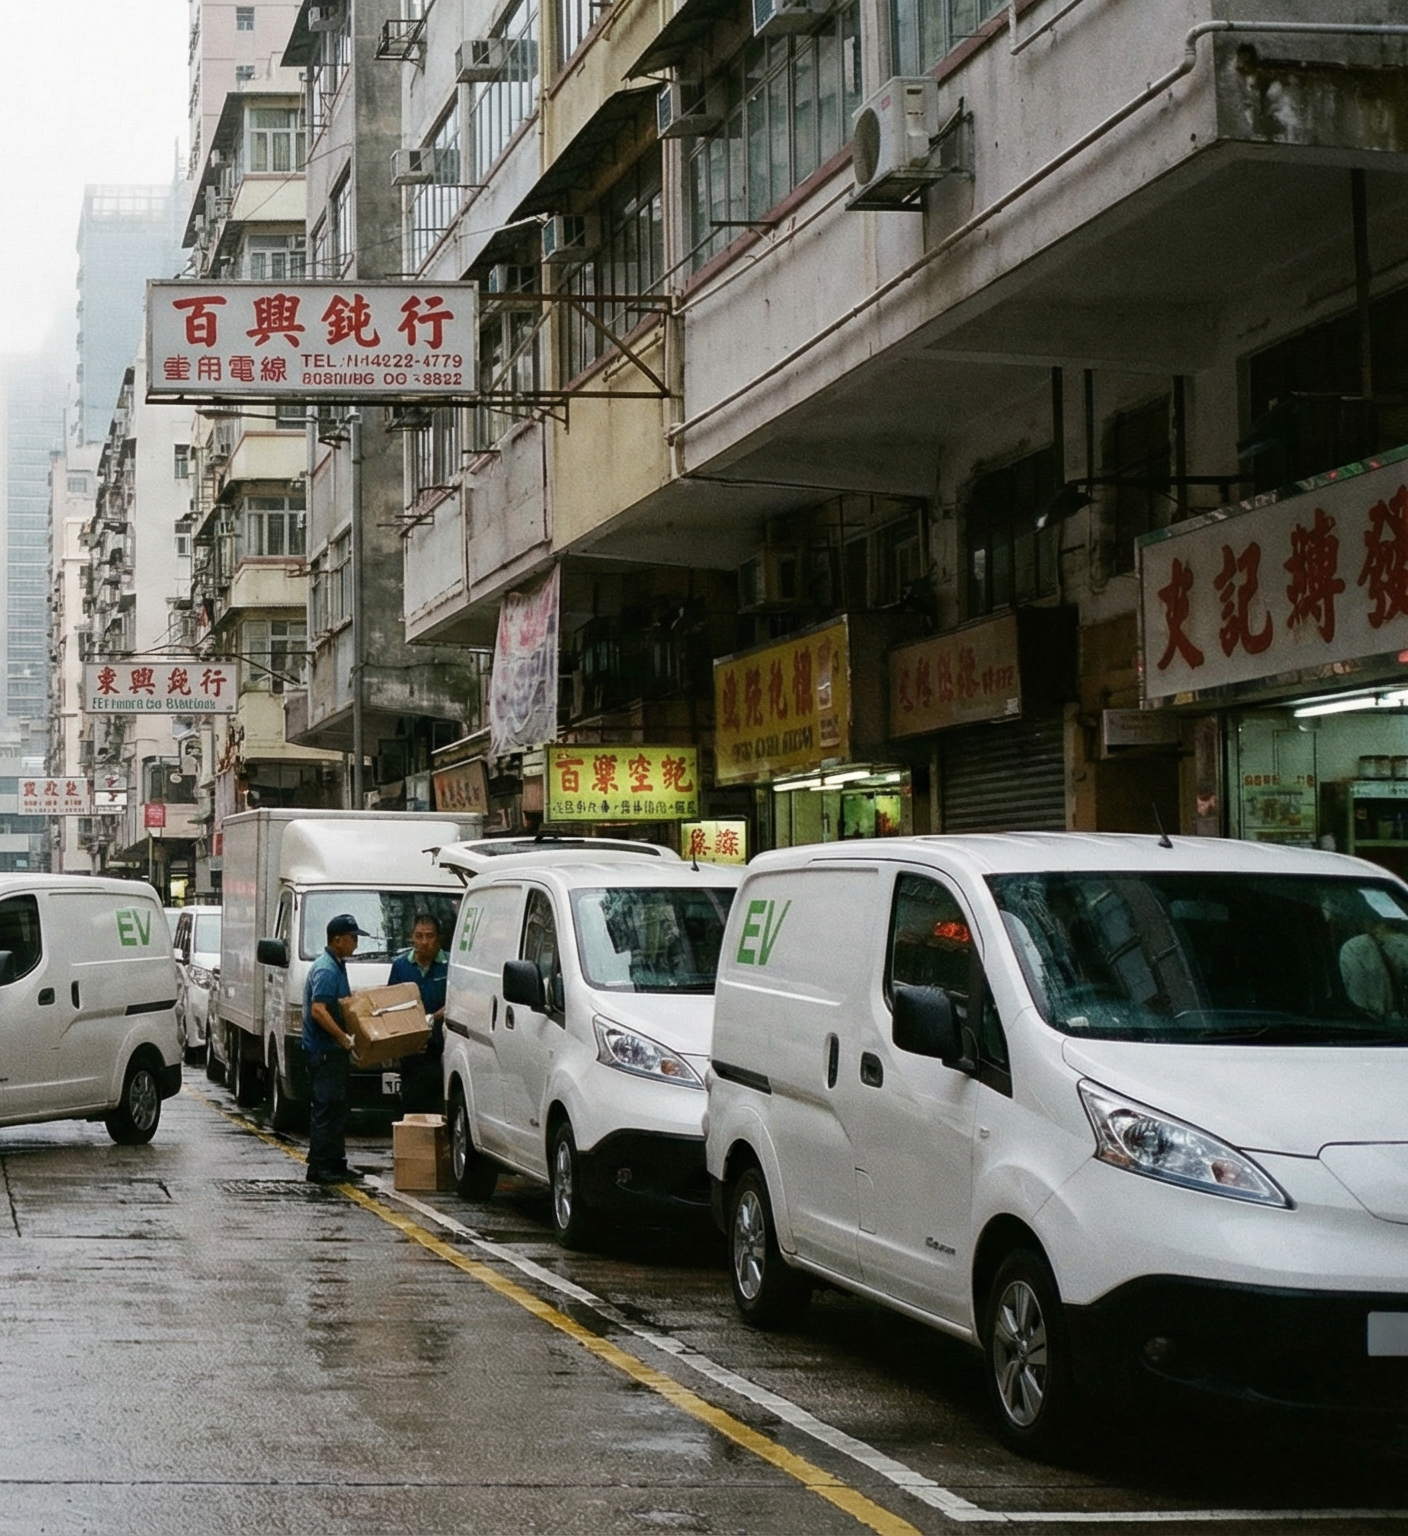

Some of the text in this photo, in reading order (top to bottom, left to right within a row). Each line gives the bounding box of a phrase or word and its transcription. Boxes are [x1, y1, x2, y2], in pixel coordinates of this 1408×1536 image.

[116, 908, 152, 946] EV
[459, 905, 484, 952] EV
[736, 900, 792, 965] EV
